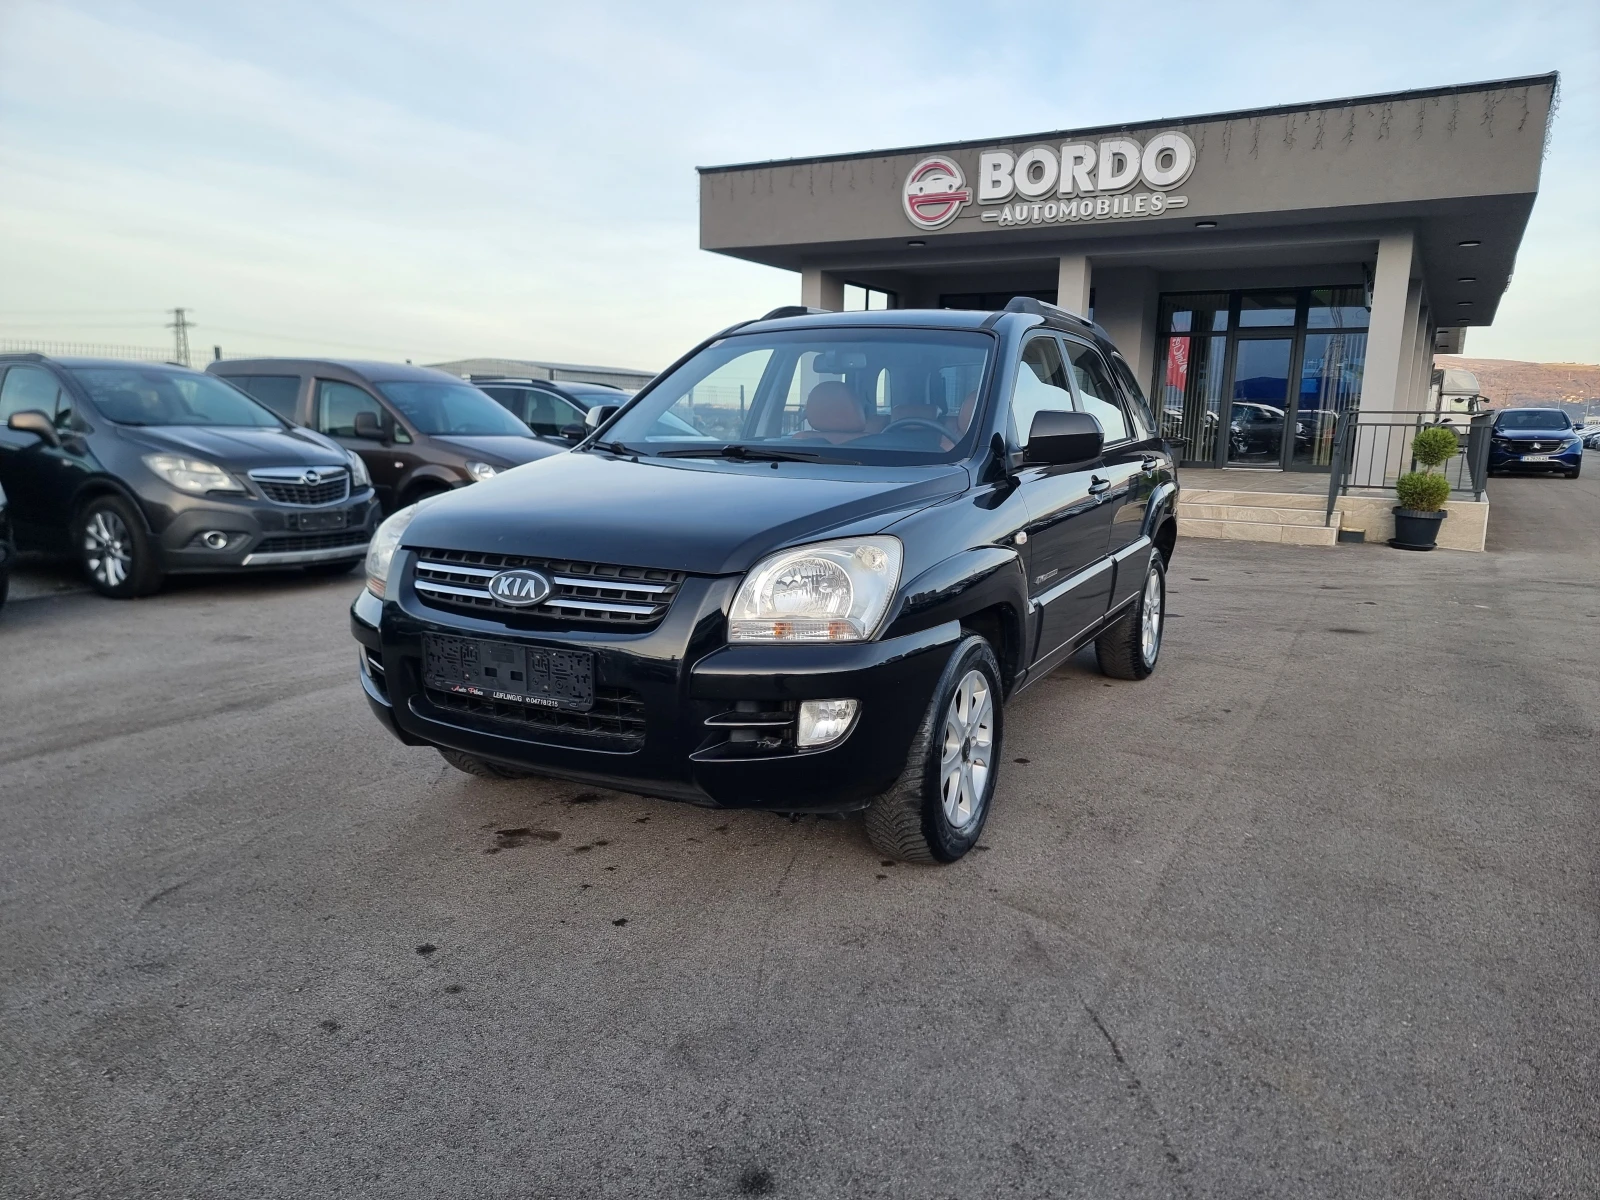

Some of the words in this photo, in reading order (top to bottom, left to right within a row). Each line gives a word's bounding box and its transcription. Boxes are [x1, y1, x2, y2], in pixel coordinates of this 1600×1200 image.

[978, 133, 1193, 200] BORDO
[1000, 195, 1164, 222] AUTOMOBILES
[497, 576, 536, 599] KIA
